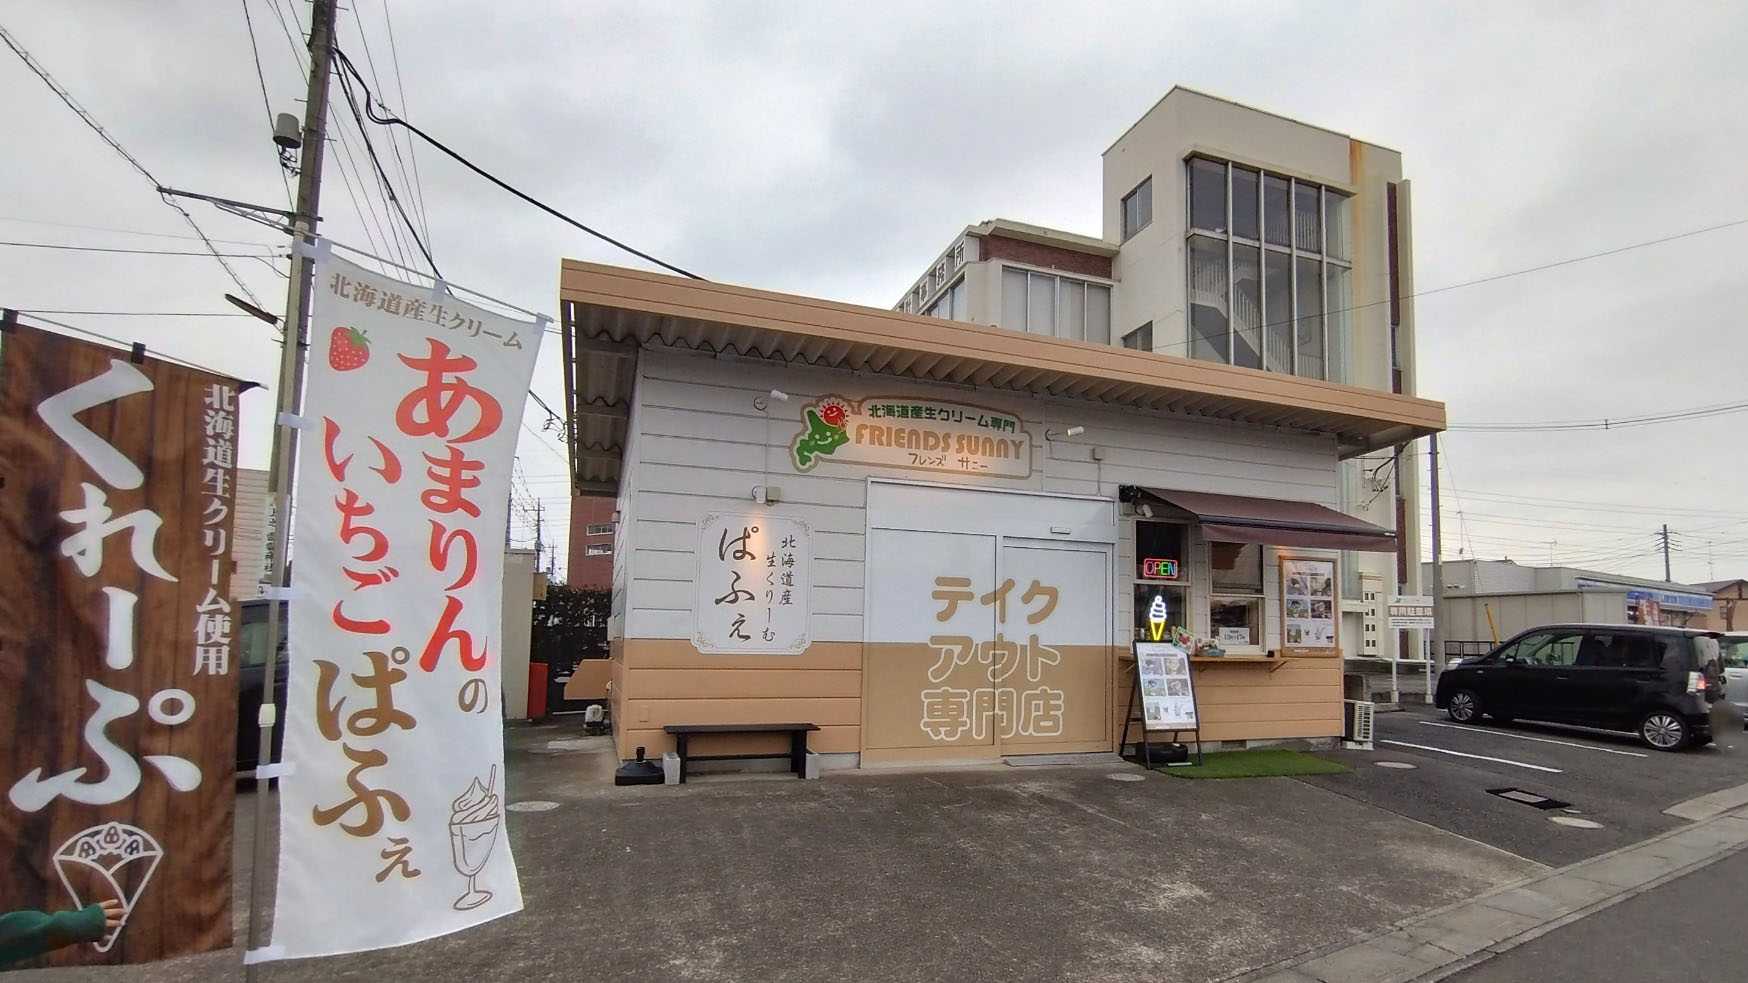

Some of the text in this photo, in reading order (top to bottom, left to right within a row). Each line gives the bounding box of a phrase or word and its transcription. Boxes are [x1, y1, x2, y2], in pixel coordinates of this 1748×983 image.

[329, 272, 523, 350] 北海道産生クリーム
[855, 423, 1025, 460] FRIENDS SUNNY
[867, 403, 1016, 434] 北海道産生クリーム専門
[907, 453, 989, 470] フレンズ サニー
[193, 383, 238, 676] 北海道生クリーム使用
[395, 337, 503, 714] あまりんの
[9, 358, 203, 812] くれーぷ
[762, 551, 776, 642] 生くりーむ
[779, 534, 797, 606] 北海道産
[1145, 561, 1176, 576] OPEN
[931, 576, 1059, 625] テイク
[928, 632, 1061, 683] アウト
[920, 685, 1065, 741] 専門店
